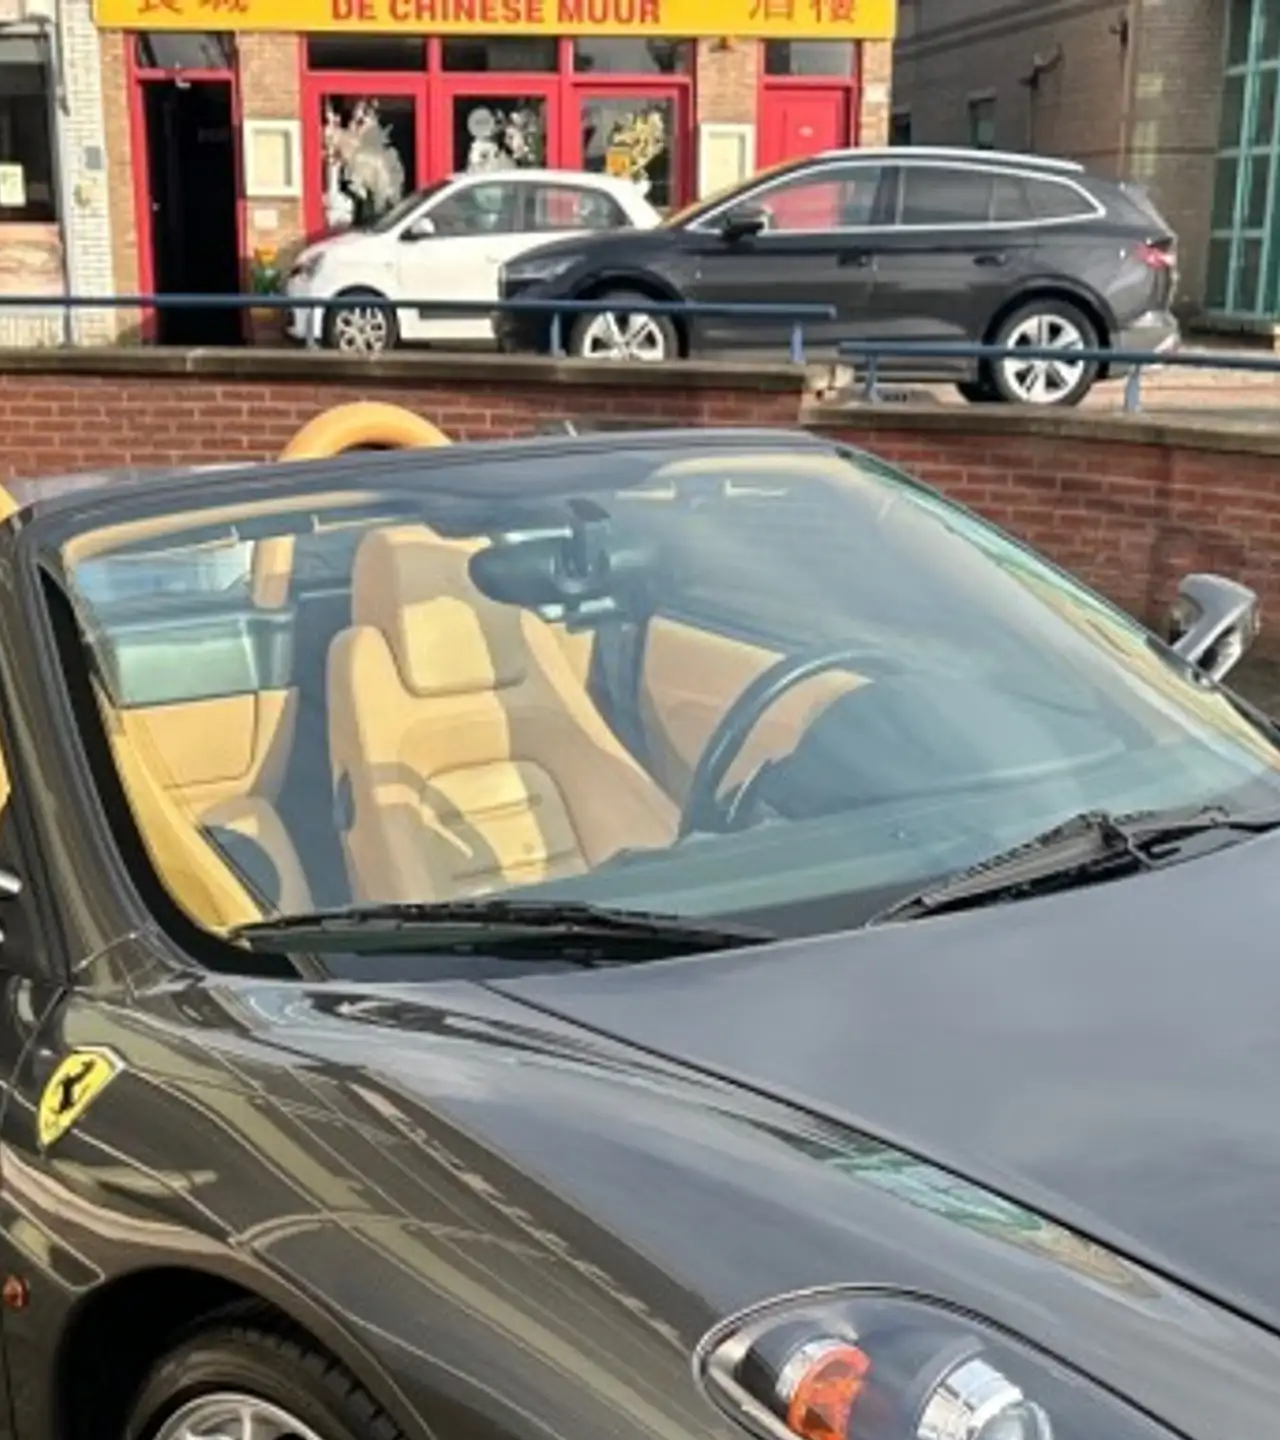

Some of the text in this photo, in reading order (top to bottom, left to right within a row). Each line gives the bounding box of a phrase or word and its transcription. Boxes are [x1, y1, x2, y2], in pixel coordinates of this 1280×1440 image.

[332, 0, 661, 25] DE CHINESE MUUR
